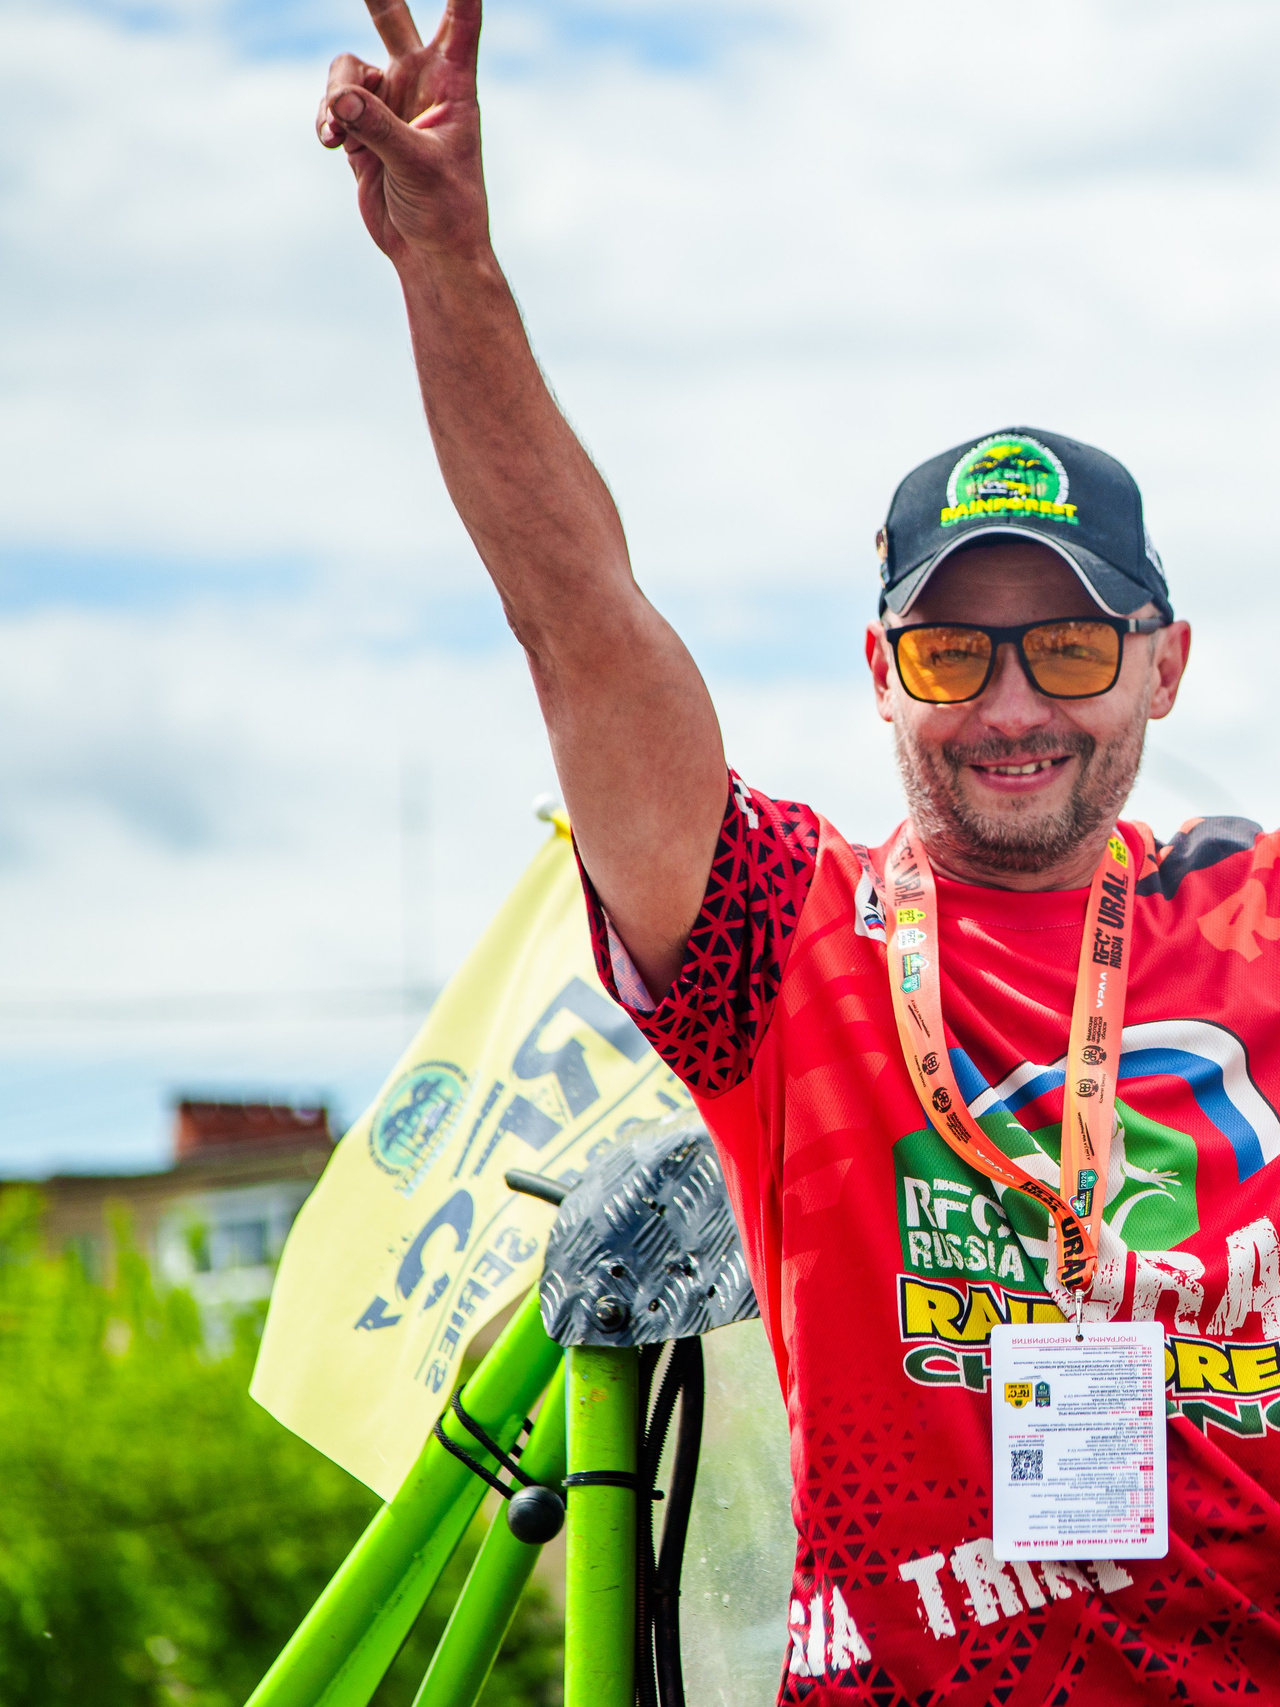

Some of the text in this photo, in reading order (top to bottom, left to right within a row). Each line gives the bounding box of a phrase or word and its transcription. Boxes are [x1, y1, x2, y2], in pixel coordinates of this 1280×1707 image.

[940, 498, 1078, 522] RAINFOREST
[1097, 872, 1127, 930] URAL
[1109, 936, 1124, 969] RUSSIA
[908, 1231, 1025, 1282] RUSSIA
[1061, 1216, 1086, 1288] URAL
[1008, 1389, 1029, 1398] RFC
